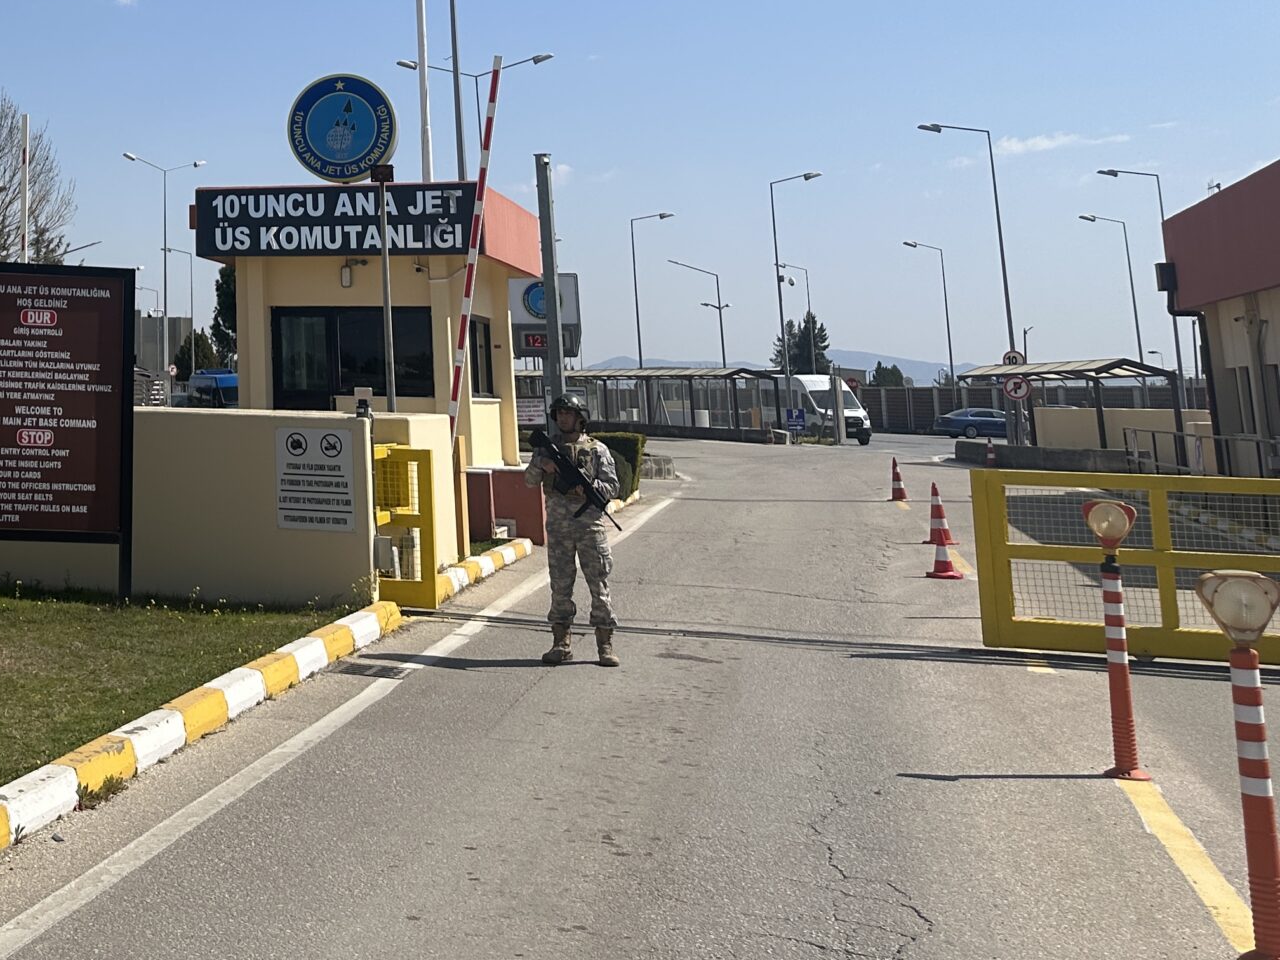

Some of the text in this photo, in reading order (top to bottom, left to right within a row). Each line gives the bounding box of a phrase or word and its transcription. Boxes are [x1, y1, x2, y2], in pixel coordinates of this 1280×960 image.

[303, 152, 320, 170] ANA
[322, 165, 342, 175] JET
[344, 164, 358, 175] ÜS
[359, 105, 390, 170] KOMUTANLIĞI
[212, 190, 462, 218] 10'UNCU ANA JET
[215, 217, 462, 251] ÜS KOMUTANLIĞI
[7, 285, 22, 294] ANA
[24, 286, 37, 295] JET
[39, 285, 49, 296] ÜS
[51, 287, 110, 298] KOMUTANLIĞINA
[17, 298, 67, 308] HOŞ GELDİNİZ
[28, 311, 50, 324] DUR
[14, 326, 63, 337] GİRİŞ KONTROLÜ
[1006, 356, 1017, 365] 10
[76, 363, 100, 371] UYUNUZ
[6, 391, 21, 399] YERE
[22, 392, 55, 401] ATMAYINIZ
[15, 405, 62, 416] WELCOME TO
[3, 417, 21, 426] MAIN
[23, 418, 37, 427] JET
[39, 418, 57, 427] BASE
[59, 419, 97, 429] COMMAND
[21, 431, 52, 444] STOP
[1, 447, 70, 457] ENTRY CONTROL POINT
[18, 460, 38, 468] INSIDE
[39, 461, 61, 469] LIGHTS
[21, 471, 41, 479] CARDS
[21, 482, 50, 490] OFFICERS
[52, 483, 96, 492] INSTRUCTIONS
[0, 492, 16, 500] YOUR
[34, 493, 53, 501] BELTS
[0, 503, 12, 511] THE
[14, 504, 39, 512] TRAFFIC
[40, 504, 60, 512] RULES
[61, 505, 70, 513] ON
[72, 505, 87, 513] BASE
